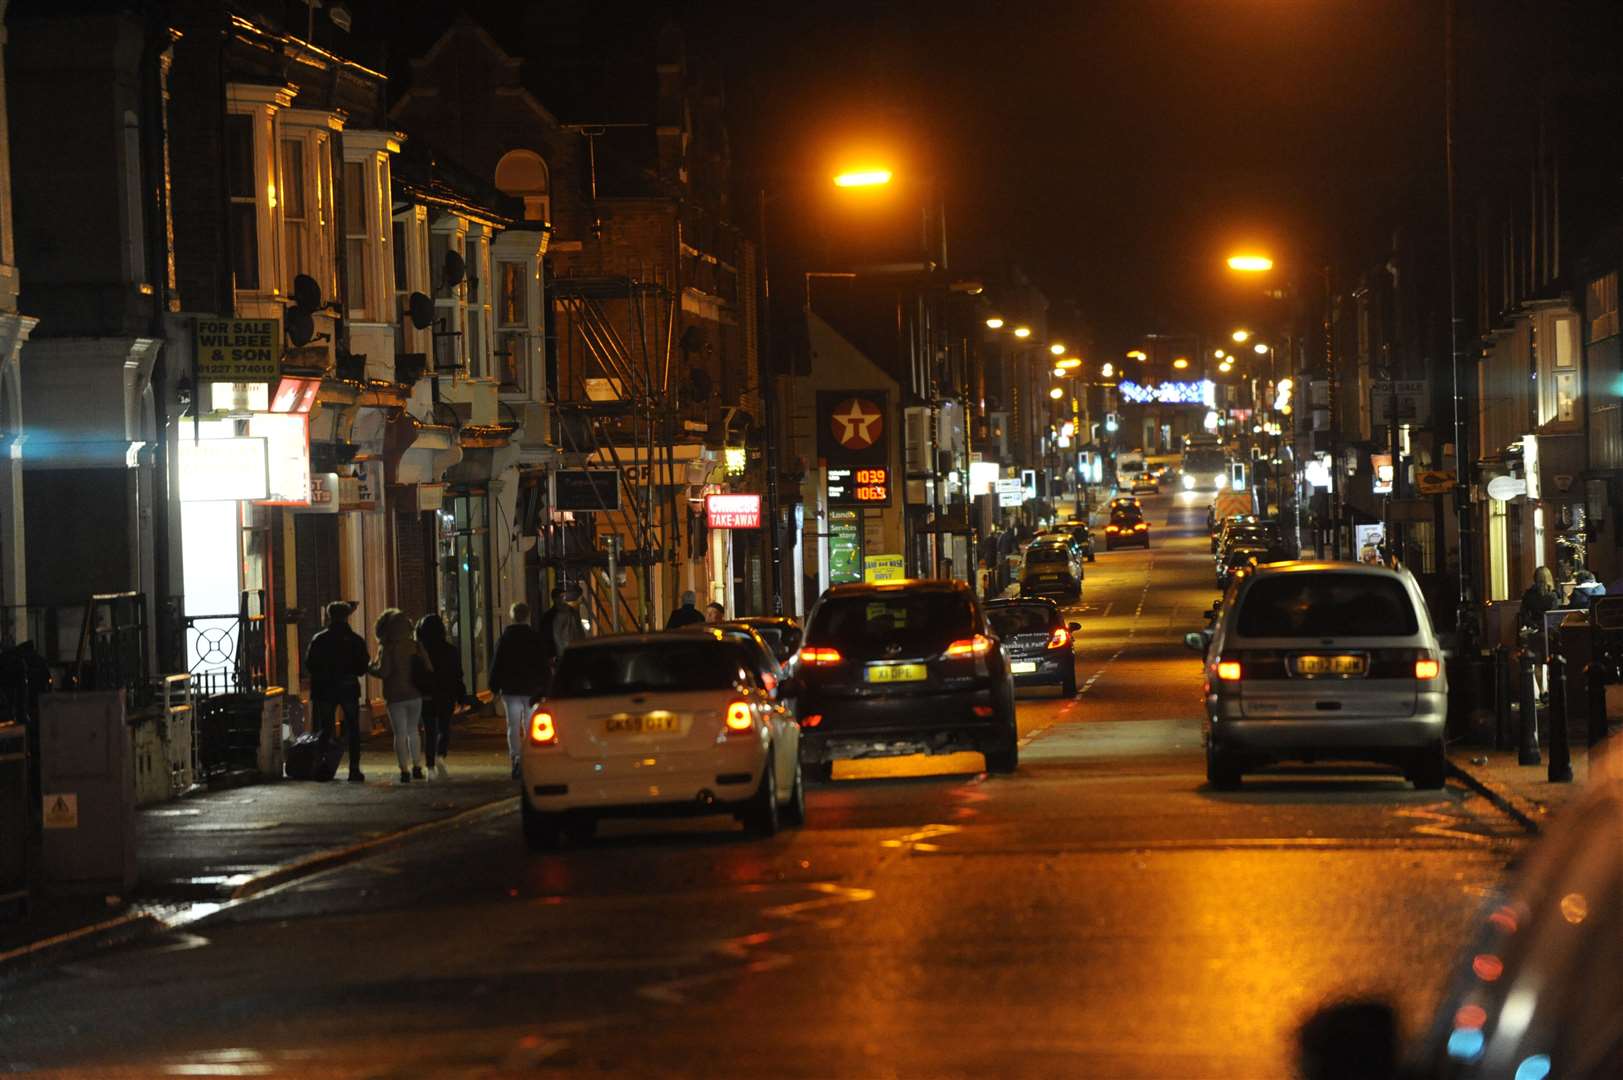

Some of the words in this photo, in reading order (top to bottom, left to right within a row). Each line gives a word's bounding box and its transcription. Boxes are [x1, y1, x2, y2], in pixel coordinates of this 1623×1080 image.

[200, 322, 227, 333] FOR
[234, 322, 271, 333] SALE
[201, 335, 271, 347] WILBEE
[212, 349, 225, 360] &
[231, 349, 271, 360] SON
[711, 514, 758, 527] TAKE-AWAY
